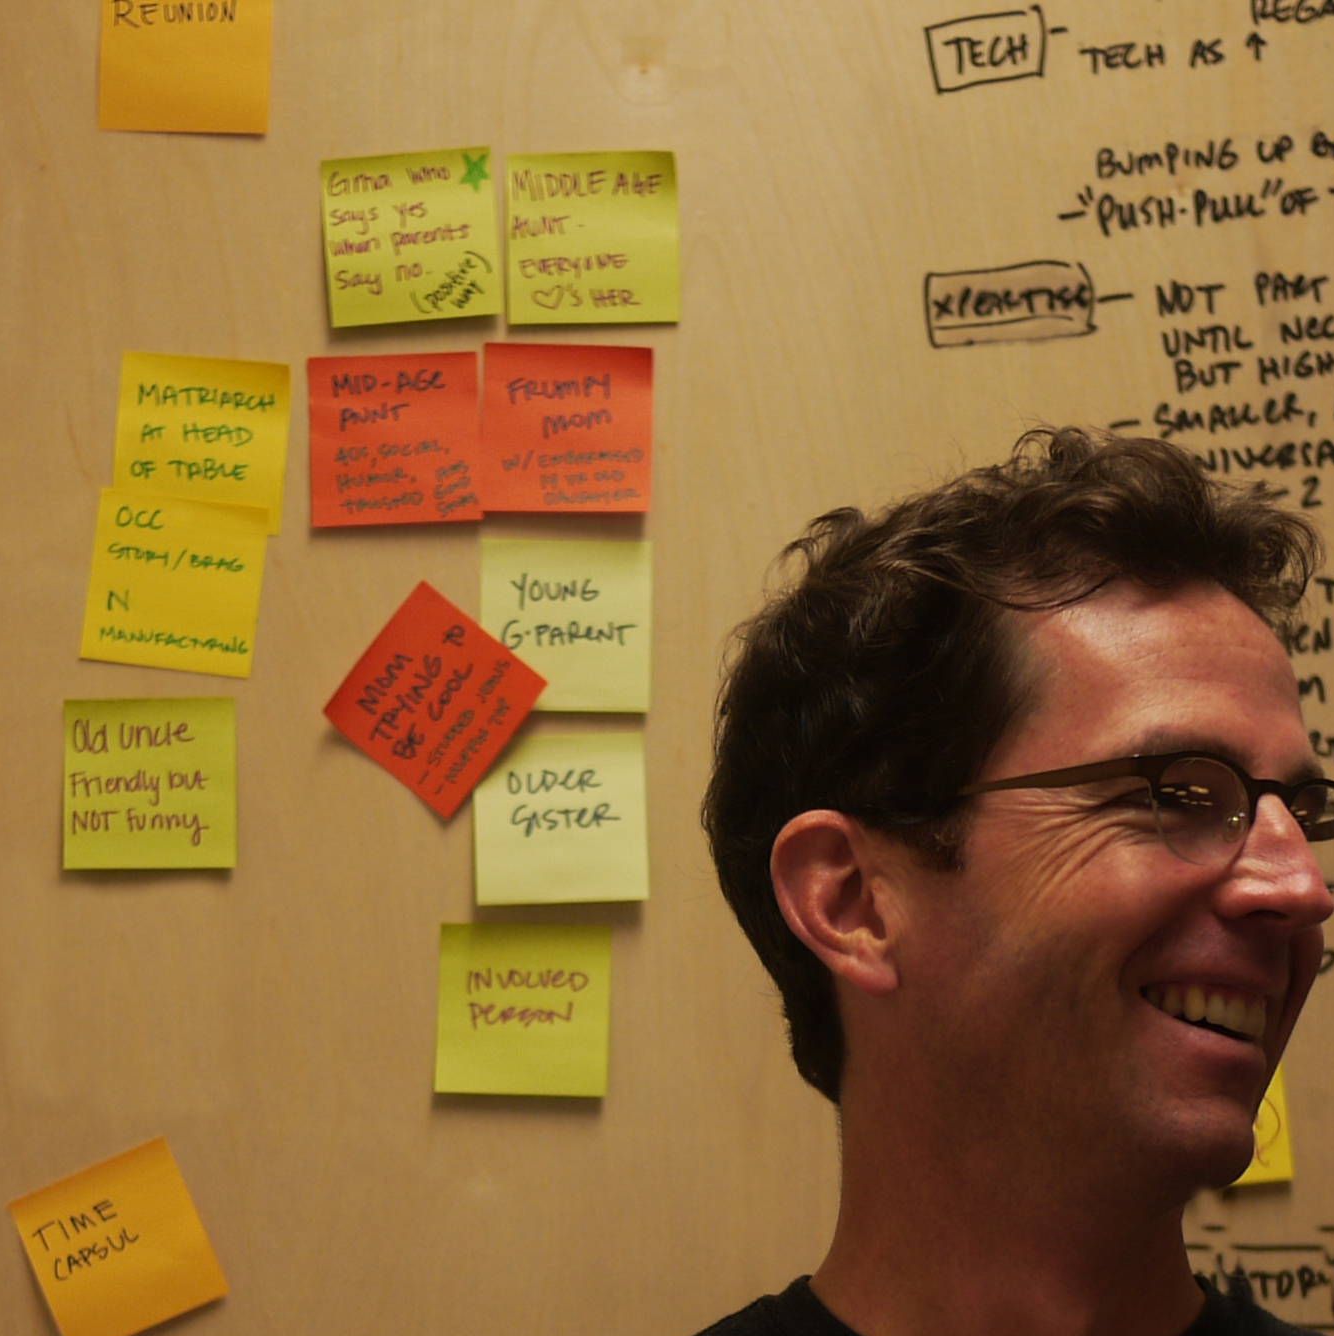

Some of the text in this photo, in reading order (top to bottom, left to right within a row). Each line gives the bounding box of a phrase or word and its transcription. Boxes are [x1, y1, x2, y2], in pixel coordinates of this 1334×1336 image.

[943, 33, 1029, 75] TECH
[1080, 38, 1225, 75] TECH AS
[1096, 138, 1239, 180] BUMPING
[1256, 134, 1294, 163] UP
[510, 168, 609, 200] MIDDLE
[1280, 186, 1320, 216] OF
[1155, 278, 1226, 318] NOT
[1254, 270, 1330, 307] PART
[1162, 325, 1254, 360] UNTIL
[506, 372, 614, 406] FRUMPY
[1174, 357, 1243, 395] BUT
[136, 382, 276, 412] MATRIARCH
[338, 401, 411, 433] AUNT
[540, 408, 615, 440] MOM
[140, 422, 255, 447] AT HEAD
[129, 458, 250, 481] OF TABLE
[1300, 475, 1324, 509] 2
[115, 505, 166, 531] OCC
[106, 589, 130, 612] N
[510, 572, 601, 611] YOUNG
[369, 653, 443, 742] TRYING
[71, 717, 110, 755] Old
[167, 768, 211, 790] but
[506, 768, 603, 796] OLDER
[71, 808, 120, 836] NOT
[466, 966, 590, 996] INVOLVED
[31, 1197, 119, 1253] TIME
